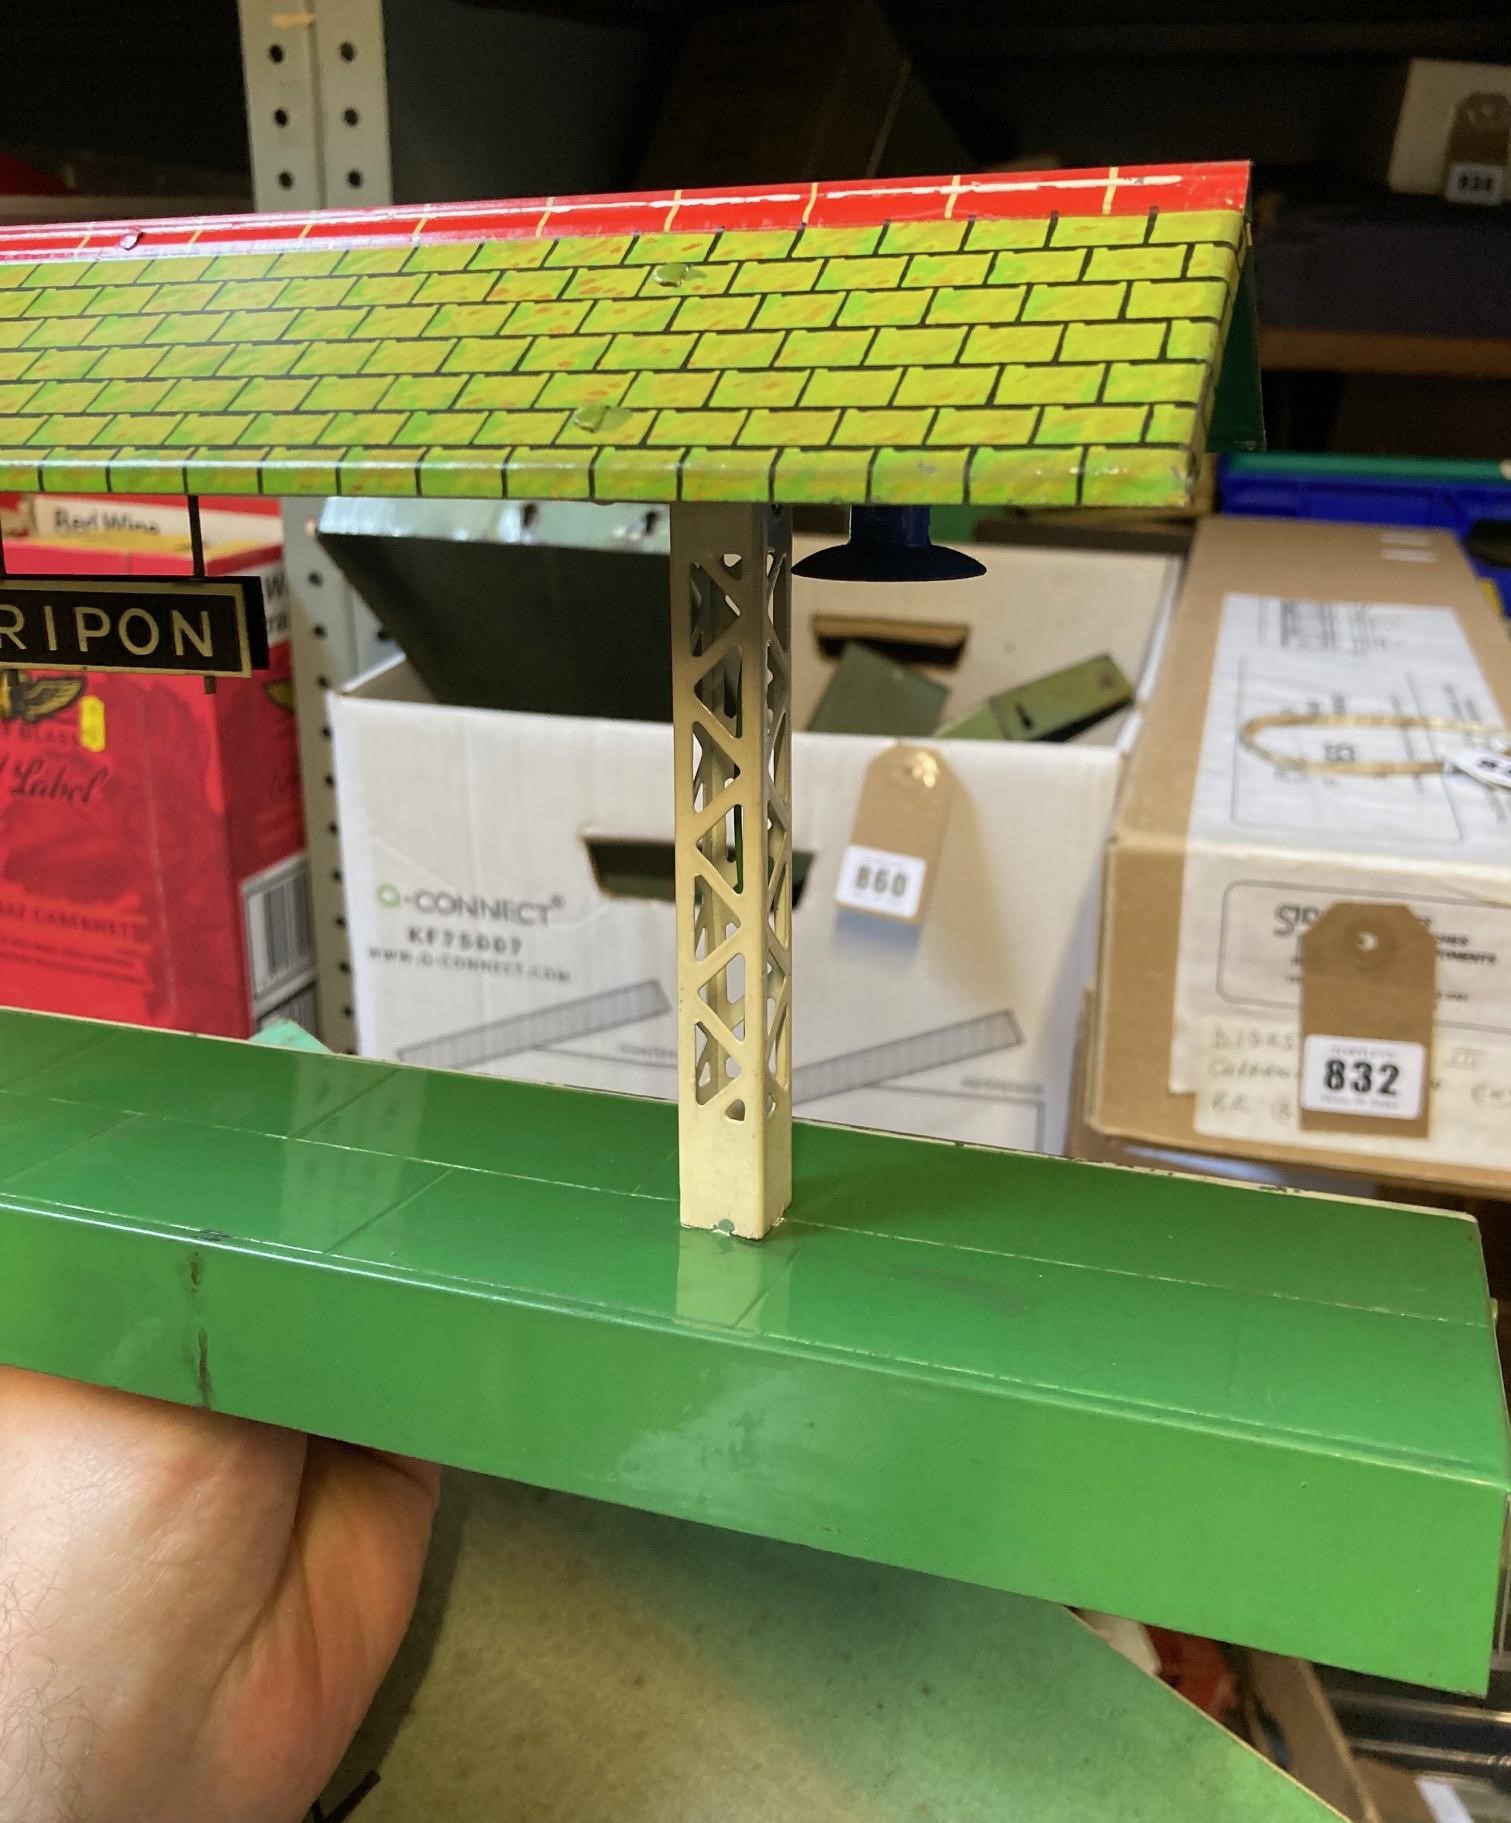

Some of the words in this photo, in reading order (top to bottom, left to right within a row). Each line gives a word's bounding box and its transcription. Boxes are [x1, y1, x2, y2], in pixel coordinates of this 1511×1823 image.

[55, 506, 97, 531] Red
[101, 510, 159, 535] Wine
[0, 604, 213, 657] RIPON
[10, 758, 109, 803] Label
[855, 864, 908, 897] 860
[1324, 1060, 1399, 1096] 832
